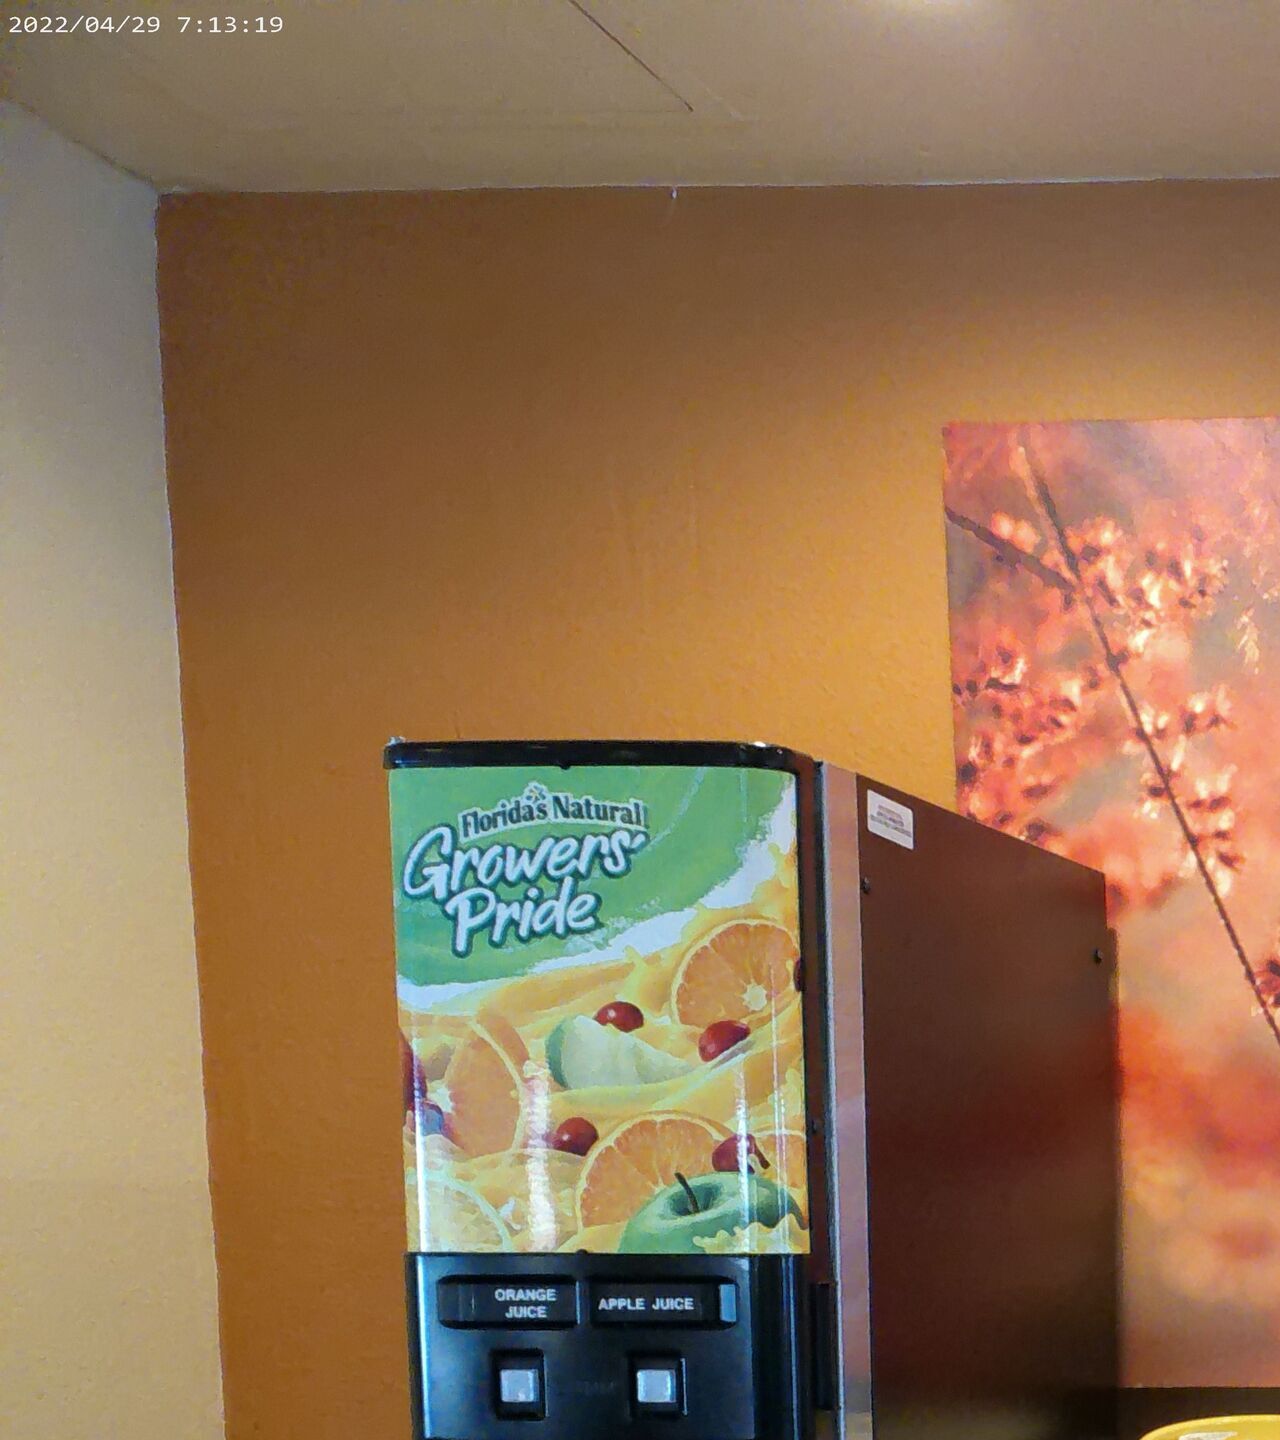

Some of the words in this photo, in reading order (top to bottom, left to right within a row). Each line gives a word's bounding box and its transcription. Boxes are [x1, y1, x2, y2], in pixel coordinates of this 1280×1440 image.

[551, 795, 643, 826] Natural
[444, 875, 598, 955] Pride
[494, 1288, 557, 1301] ORANGE
[598, 1298, 645, 1310] APPLE
[652, 1298, 694, 1310] JUICE
[505, 1305, 547, 1319] JUICE
